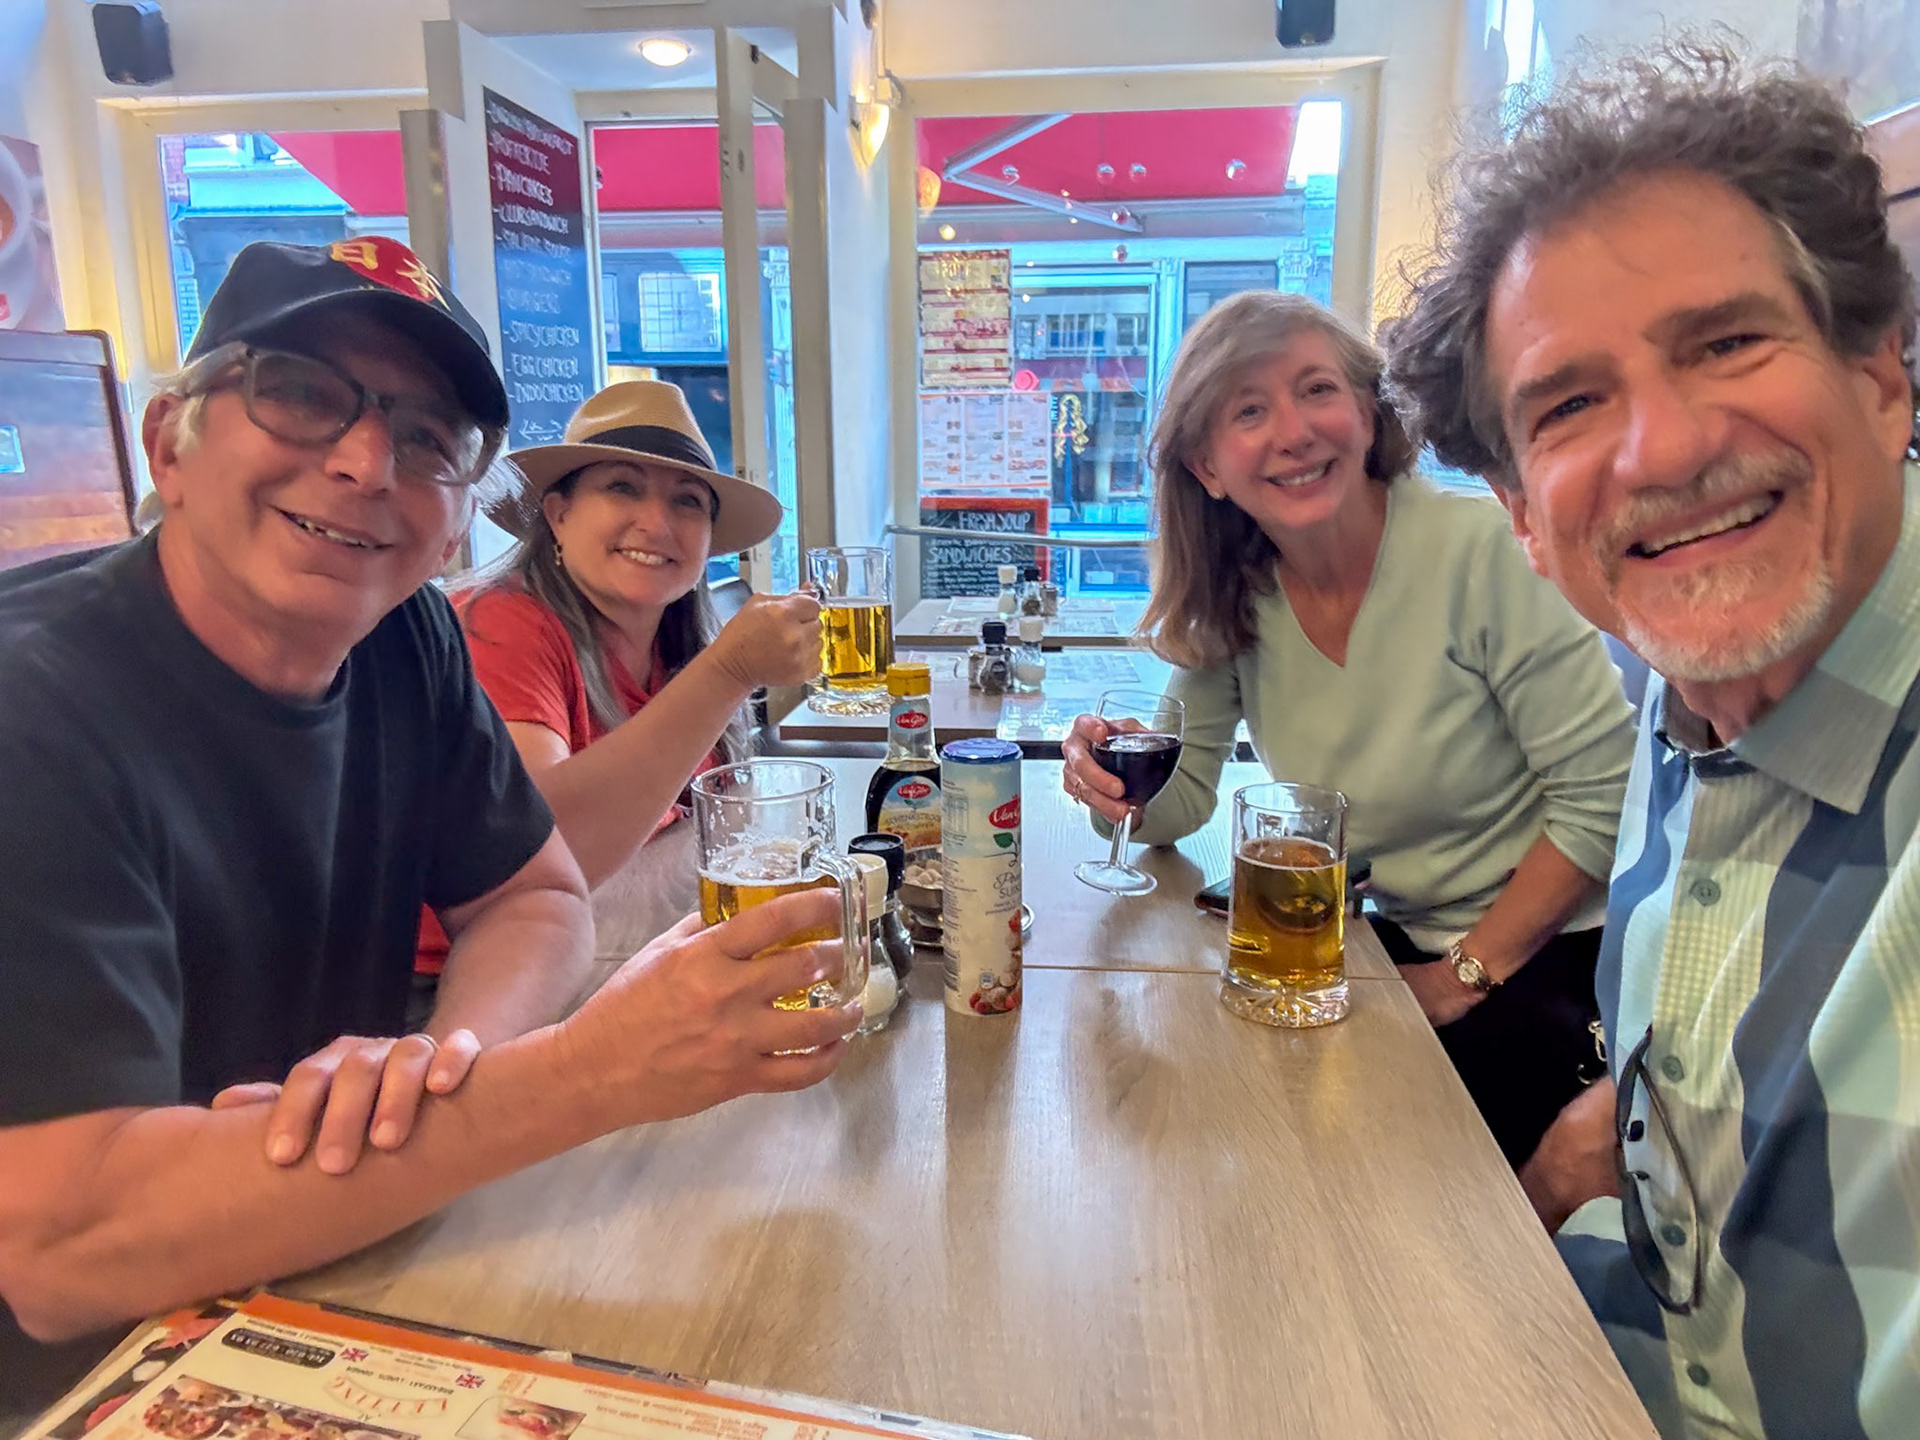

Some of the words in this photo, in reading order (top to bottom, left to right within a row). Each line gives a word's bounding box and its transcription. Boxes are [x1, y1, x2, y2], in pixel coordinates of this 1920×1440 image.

[958, 511, 996, 532] FRESH
[997, 512, 1032, 532] SOUP
[926, 546, 1012, 564] SANDWICHES
